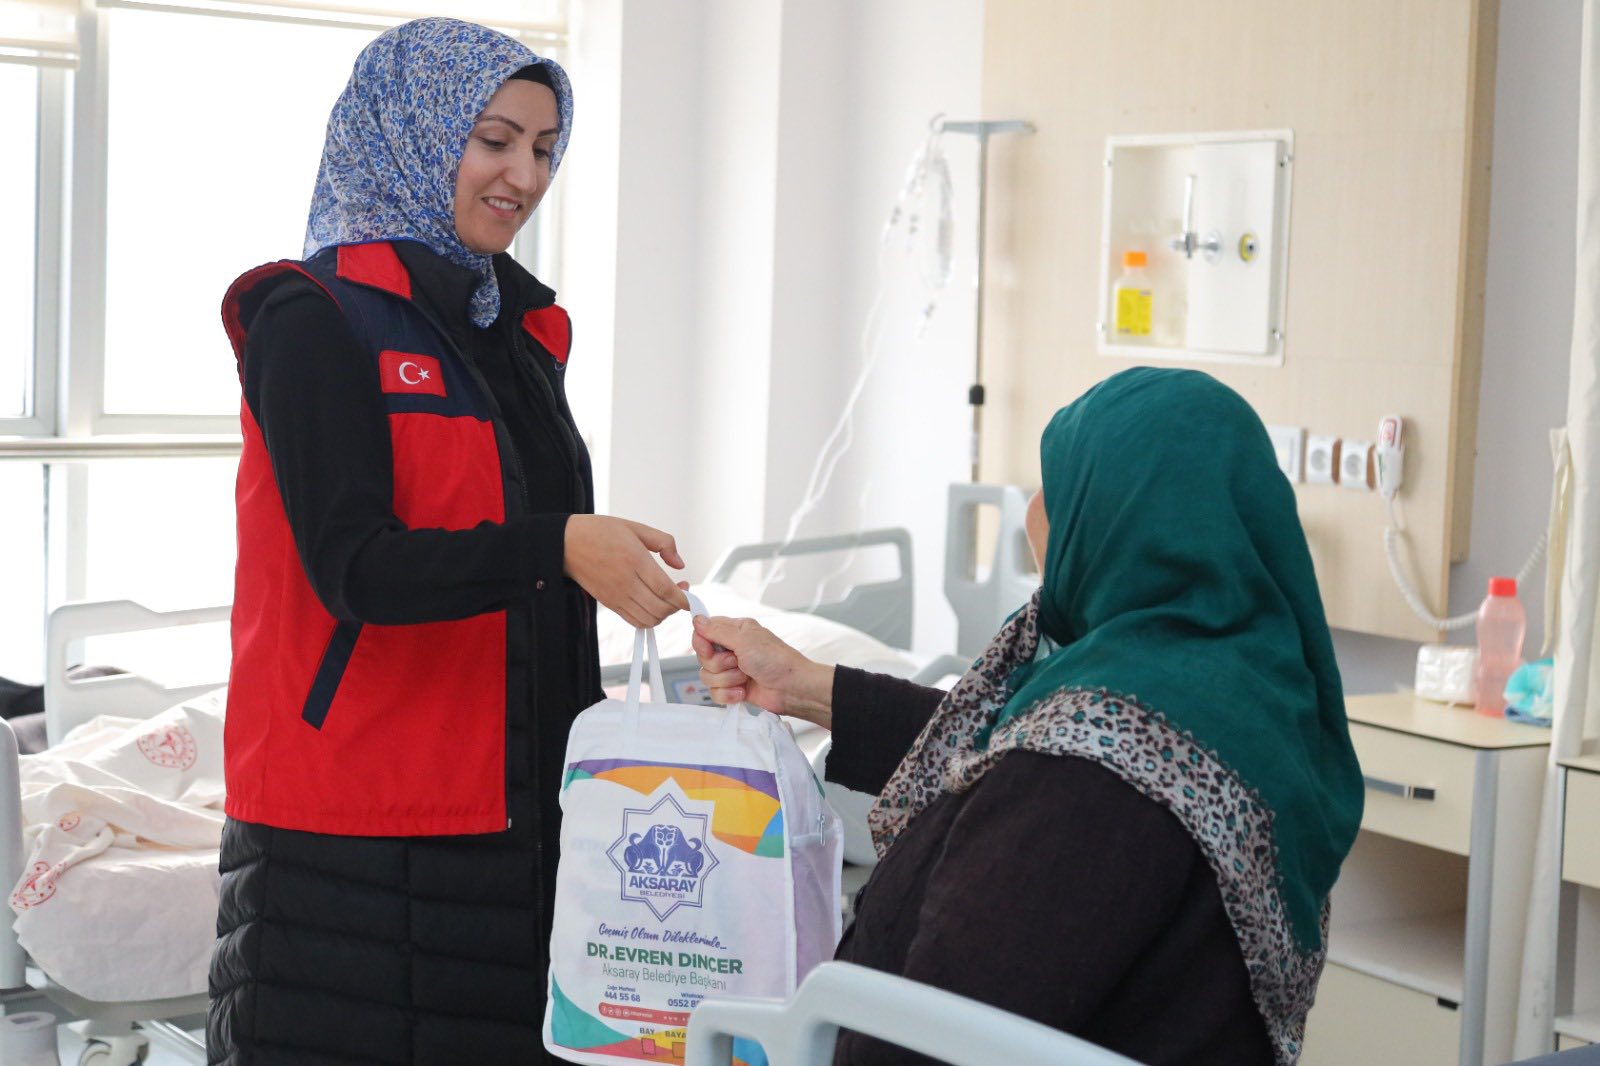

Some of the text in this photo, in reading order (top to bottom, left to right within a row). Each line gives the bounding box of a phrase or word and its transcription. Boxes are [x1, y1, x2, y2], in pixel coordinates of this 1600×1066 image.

[629, 876, 696, 893] AKSARAY
[598, 923, 628, 938] Geçmiş
[630, 927, 660, 941] Olsun
[587, 942, 673, 966] DR.EVREN
[602, 963, 727, 991] Aksaray Belediye Başkanı
[604, 991, 641, 1002] 444 55 68
[667, 998, 689, 1008] 0552
[639, 1027, 655, 1035] BAY
[665, 1030, 688, 1038] BAYA
